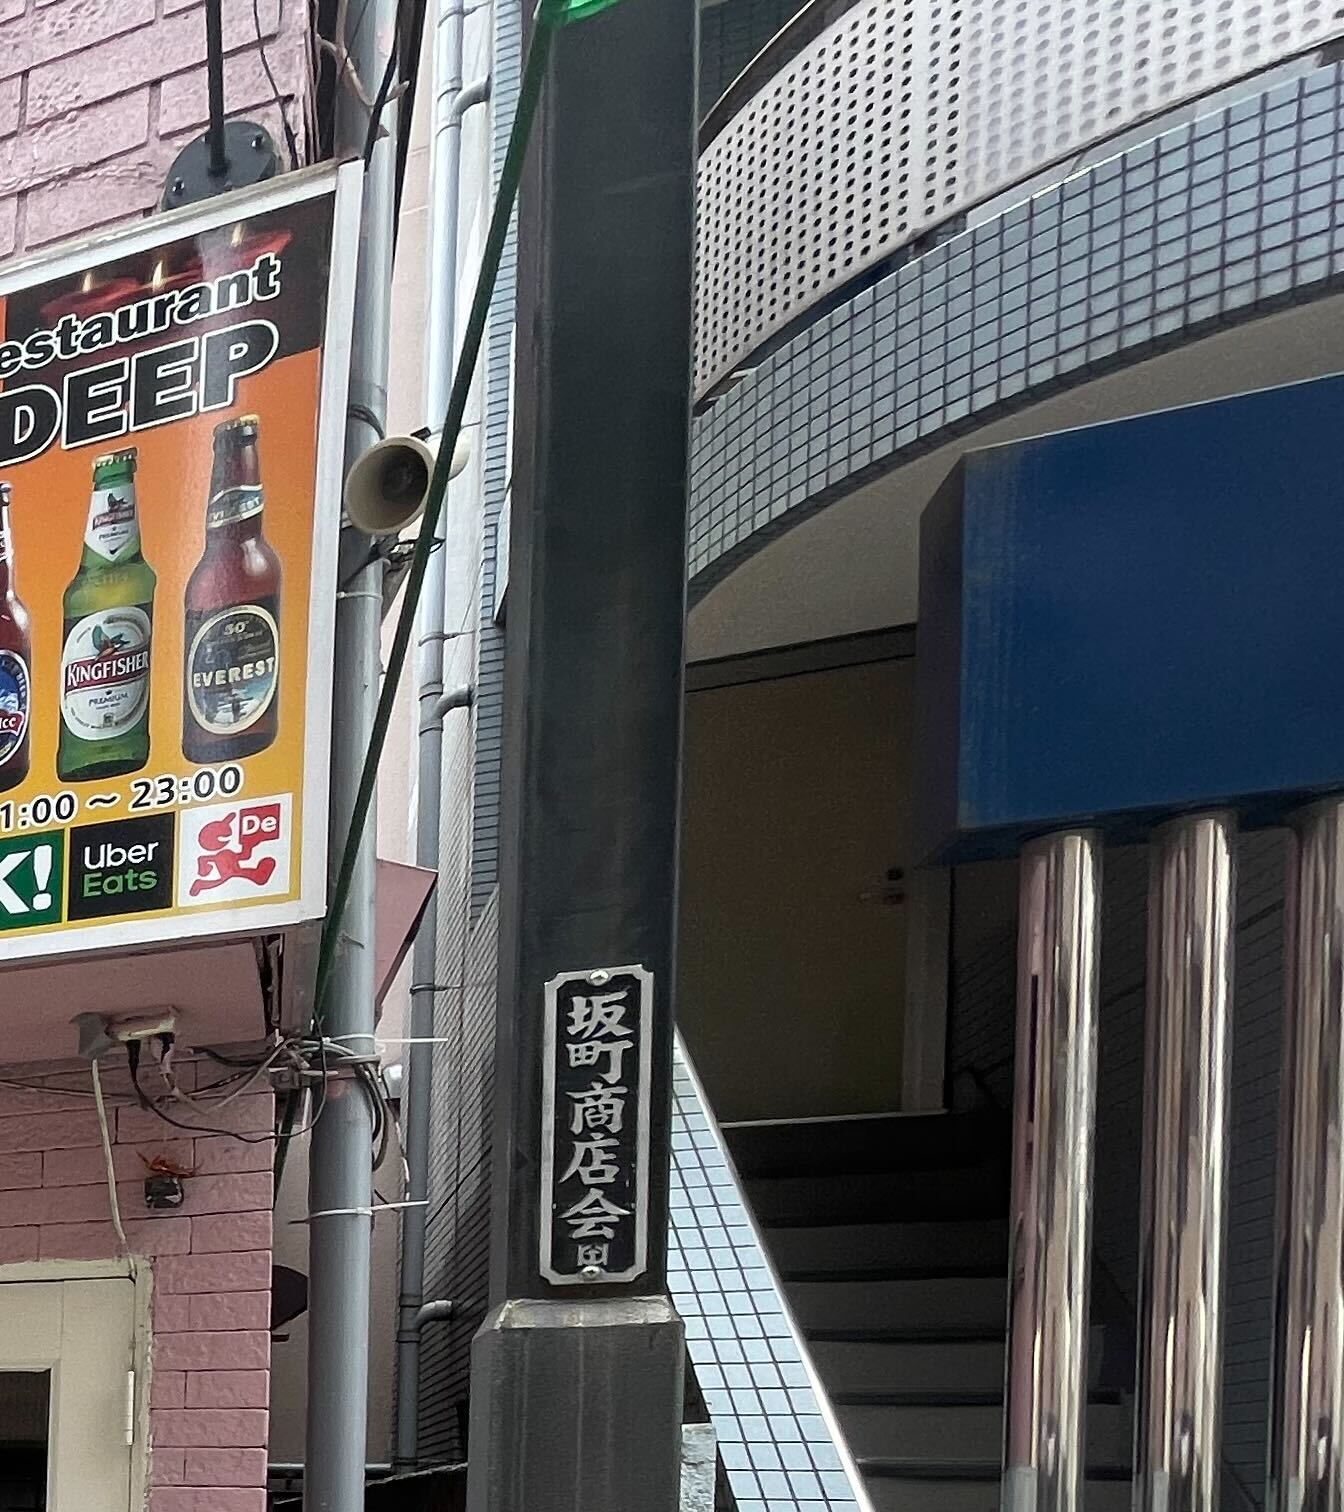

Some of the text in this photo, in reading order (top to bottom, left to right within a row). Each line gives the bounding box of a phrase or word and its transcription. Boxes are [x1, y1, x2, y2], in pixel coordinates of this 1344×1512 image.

[67, 651, 149, 687] KINGFISHER
[193, 658, 275, 688] EVEREST
[130, 765, 243, 811] 23:00
[84, 838, 160, 870] Uber
[82, 867, 159, 897] Eats
